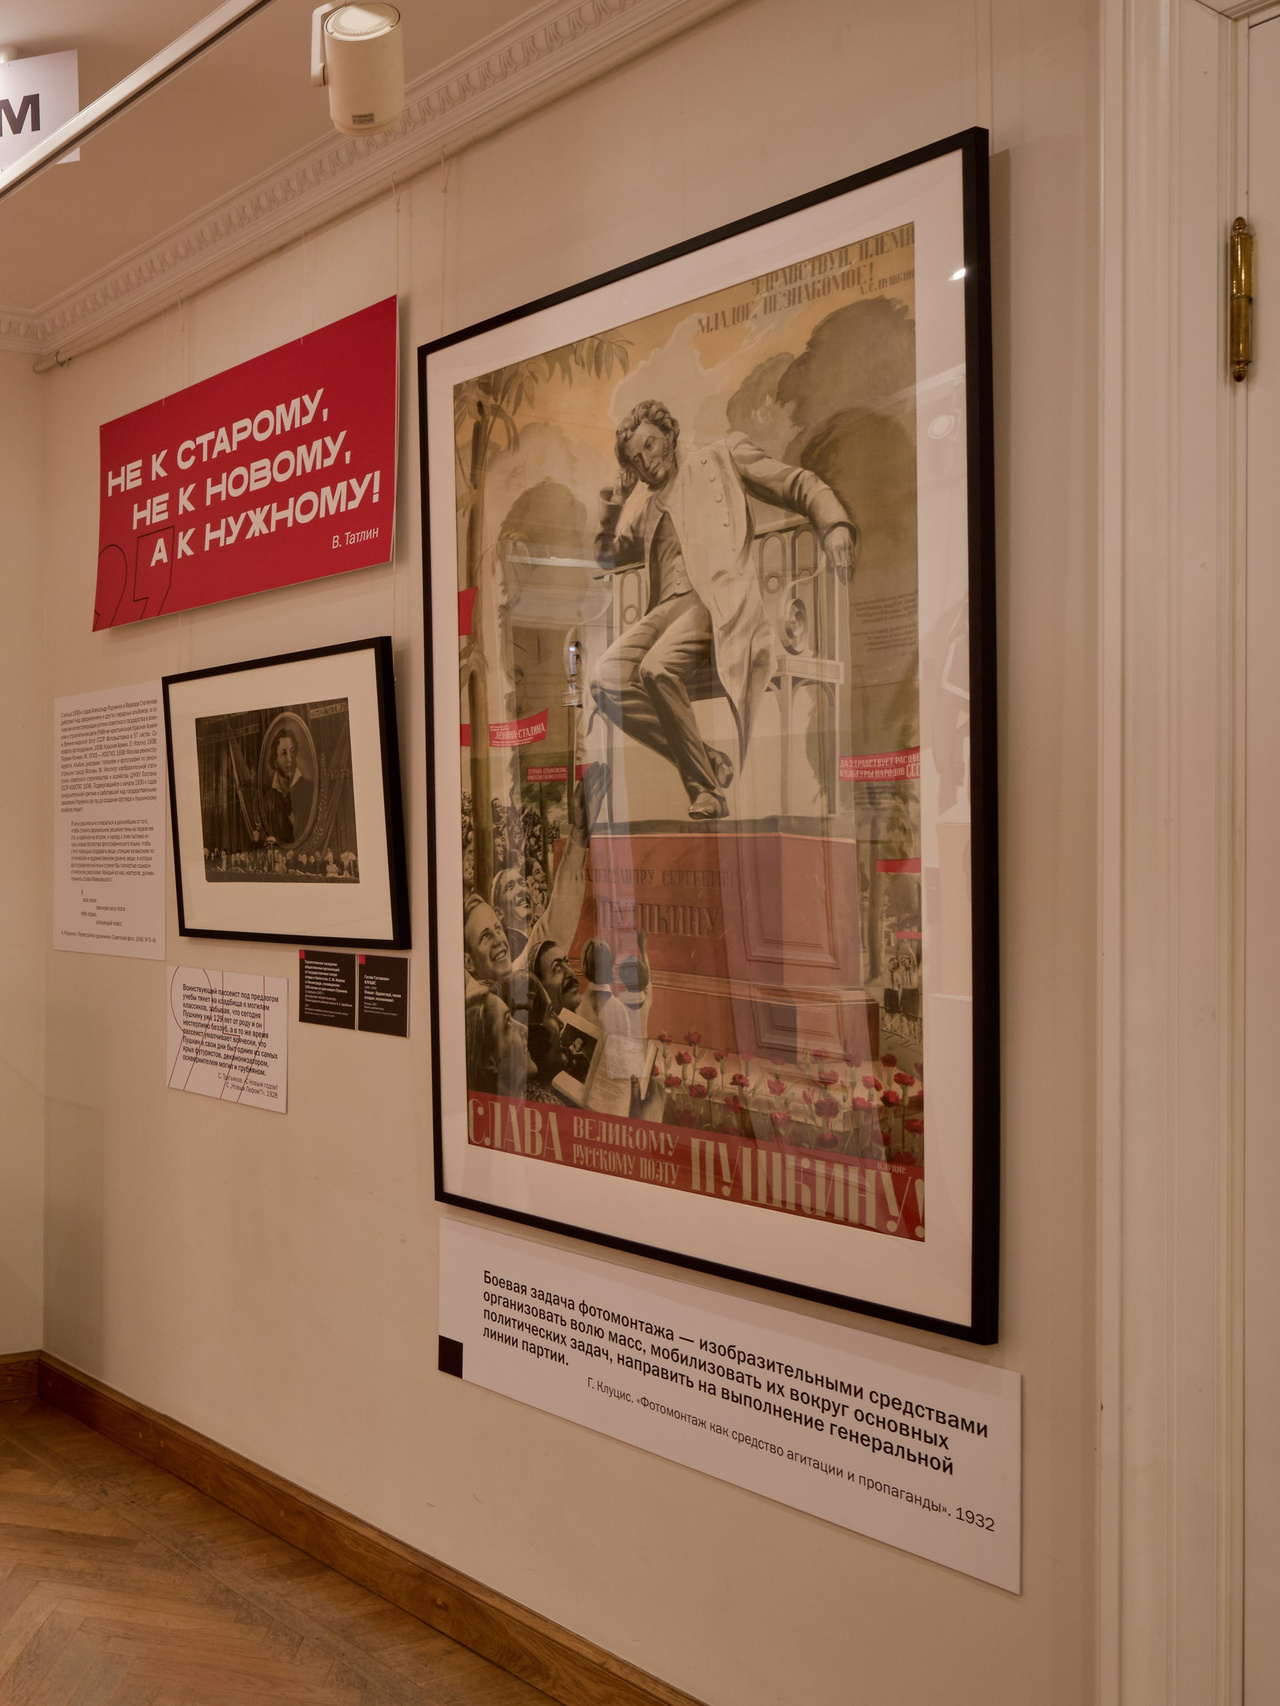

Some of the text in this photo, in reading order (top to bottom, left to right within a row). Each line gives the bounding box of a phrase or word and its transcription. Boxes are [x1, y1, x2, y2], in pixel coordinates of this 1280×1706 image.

[763, 262, 874, 316] НЕЗНАКОМОЕ!
[107, 388, 328, 497] НЕ К СТАРОМУ,
[133, 430, 351, 530] НЕ К НОВОМУ,
[150, 470, 381, 567] А К НУЖНОМУ!
[331, 527, 379, 549] В. Татлин
[182, 983, 278, 1002] Воинствующий пассеист под предлогом
[182, 993, 196, 1001] учебы
[217, 998, 242, 1008] кладбища
[247, 1002, 269, 1010] могилам
[208, 1004, 231, 1016] забывая,
[240, 1010, 260, 1019] сегодня
[182, 1009, 202, 1020] Пушкину
[213, 1013, 223, 1022] 129
[239, 1019, 250, 1027] роду
[182, 1019, 210, 1029] нестерпимо
[252, 1030, 268, 1038] время
[182, 1028, 203, 1037] пассеист
[203, 1031, 232, 1042] умалчивает
[182, 1035, 200, 1045] Пушкин
[226, 1042, 236, 1052] был
[237, 1046, 253, 1055] одним
[260, 1050, 277, 1059] самых
[182, 1054, 218, 1066] осквернителем
[218, 1061, 233, 1069] могил
[238, 1064, 266, 1076] грубияном.
[194, 1046, 222, 1060] футуристов,
[223, 1053, 269, 1068] деканонизатором,
[468, 1098, 564, 1162] СЛАВА
[573, 1116, 679, 1156] ВЕЛИКОМУ
[573, 1144, 680, 1185] РУССКОМУ ПОЭТУ
[690, 1137, 925, 1239] ПУШКИНУ!
[482, 1326, 569, 1366] линии партии.
[483, 1269, 987, 1438] Боевая задача фотомонтажа — изобразительными средствами
[482, 1290, 949, 1450] организовать волю масс, мобилизовать их вокруг основных
[483, 1308, 953, 1475] политических задач, направить на выполнение генеральной
[587, 1376, 994, 1532] Г. Клуцис. «Фотомонтаж как средство агитации и пропаганды». 1932
